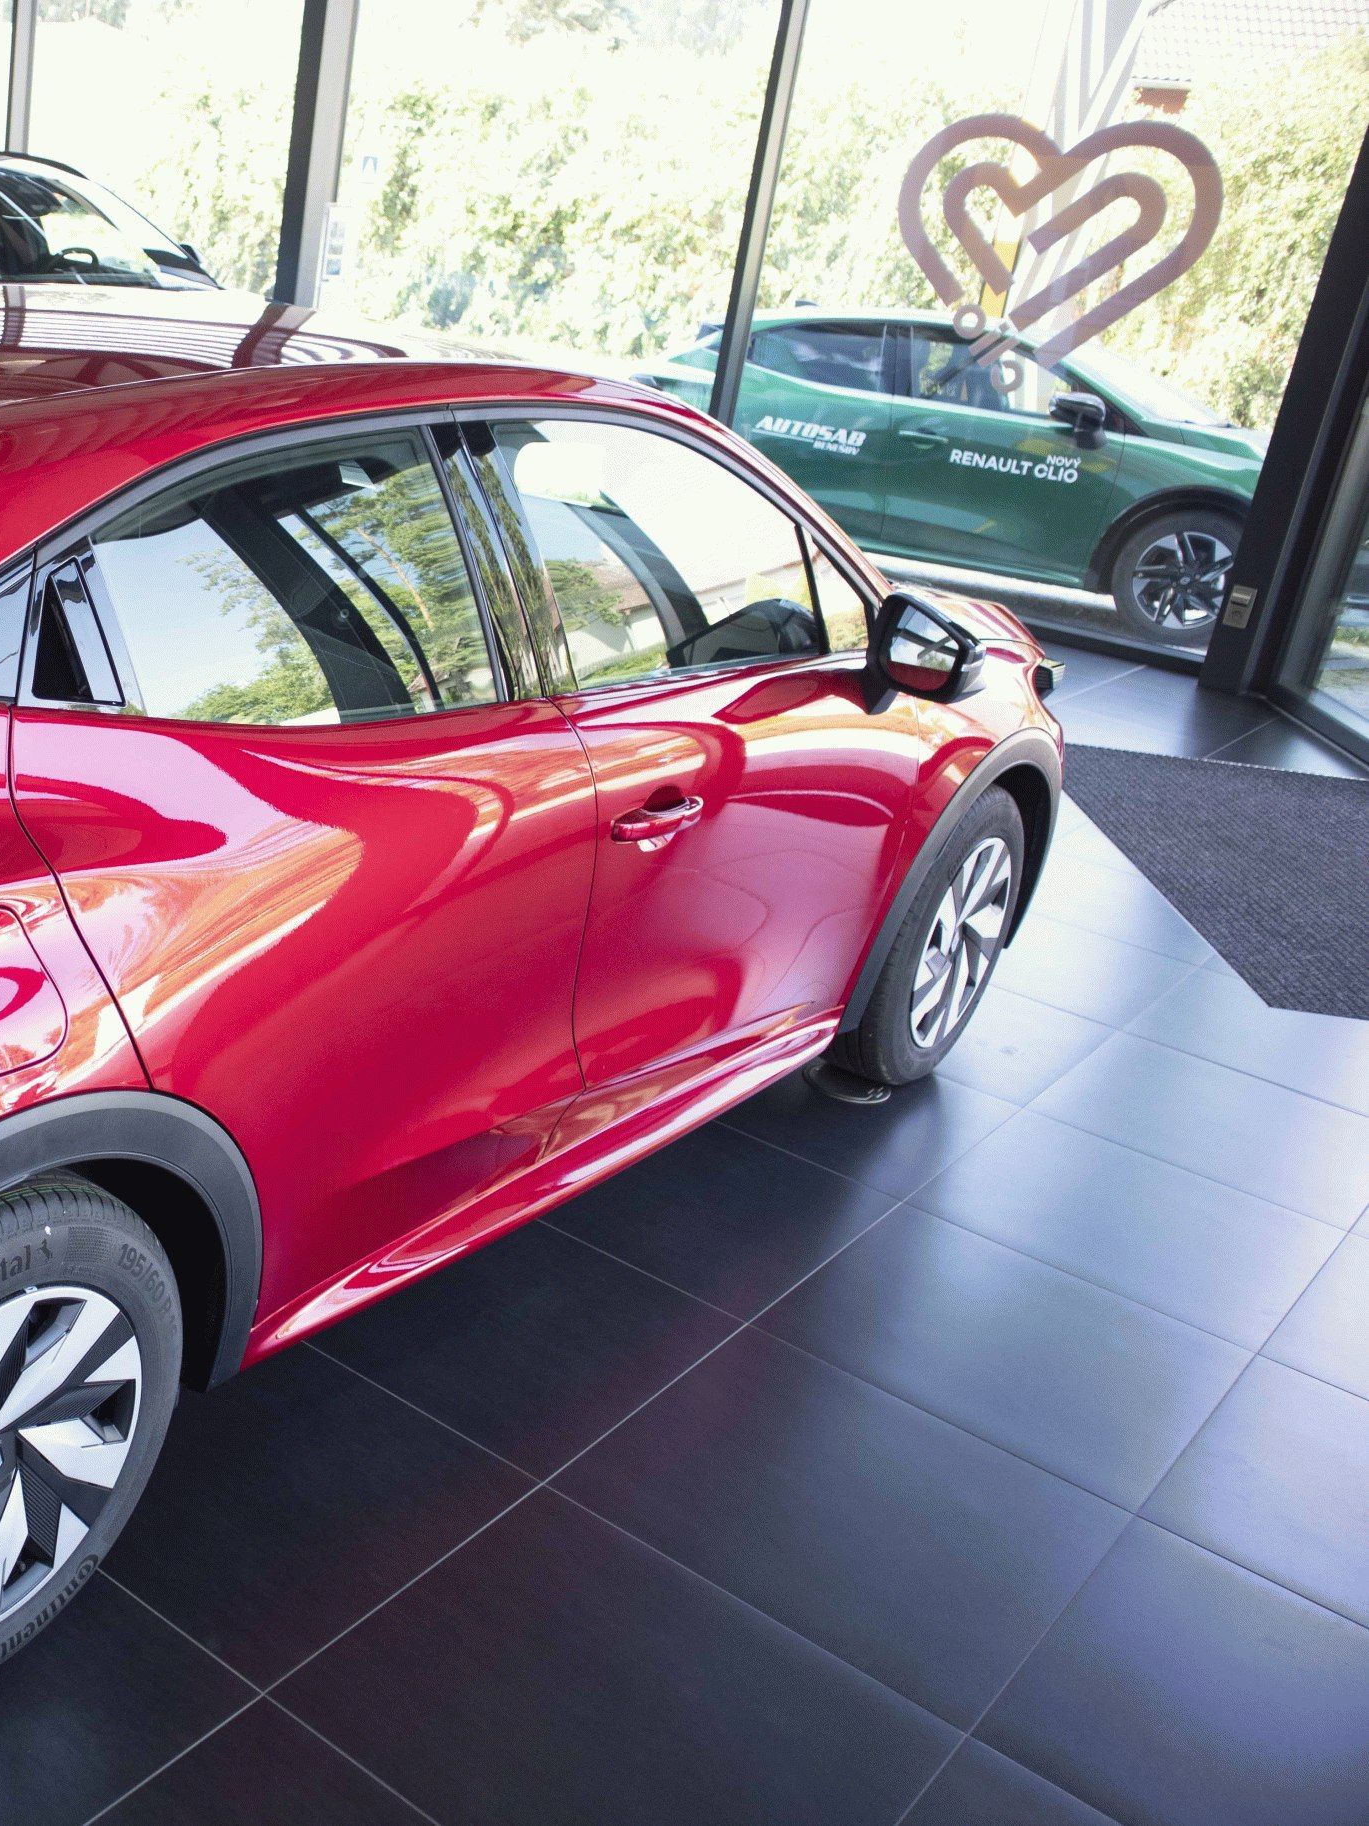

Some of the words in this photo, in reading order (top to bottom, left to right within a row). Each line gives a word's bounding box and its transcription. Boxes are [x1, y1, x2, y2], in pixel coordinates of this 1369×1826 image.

[755, 415, 868, 447] AUTOSAB
[950, 448, 1034, 476] RENAULT
[1033, 463, 1079, 484] CLIO
[1046, 455, 1082, 469] NOVÝ
[117, 1243, 166, 1304] 195/60
